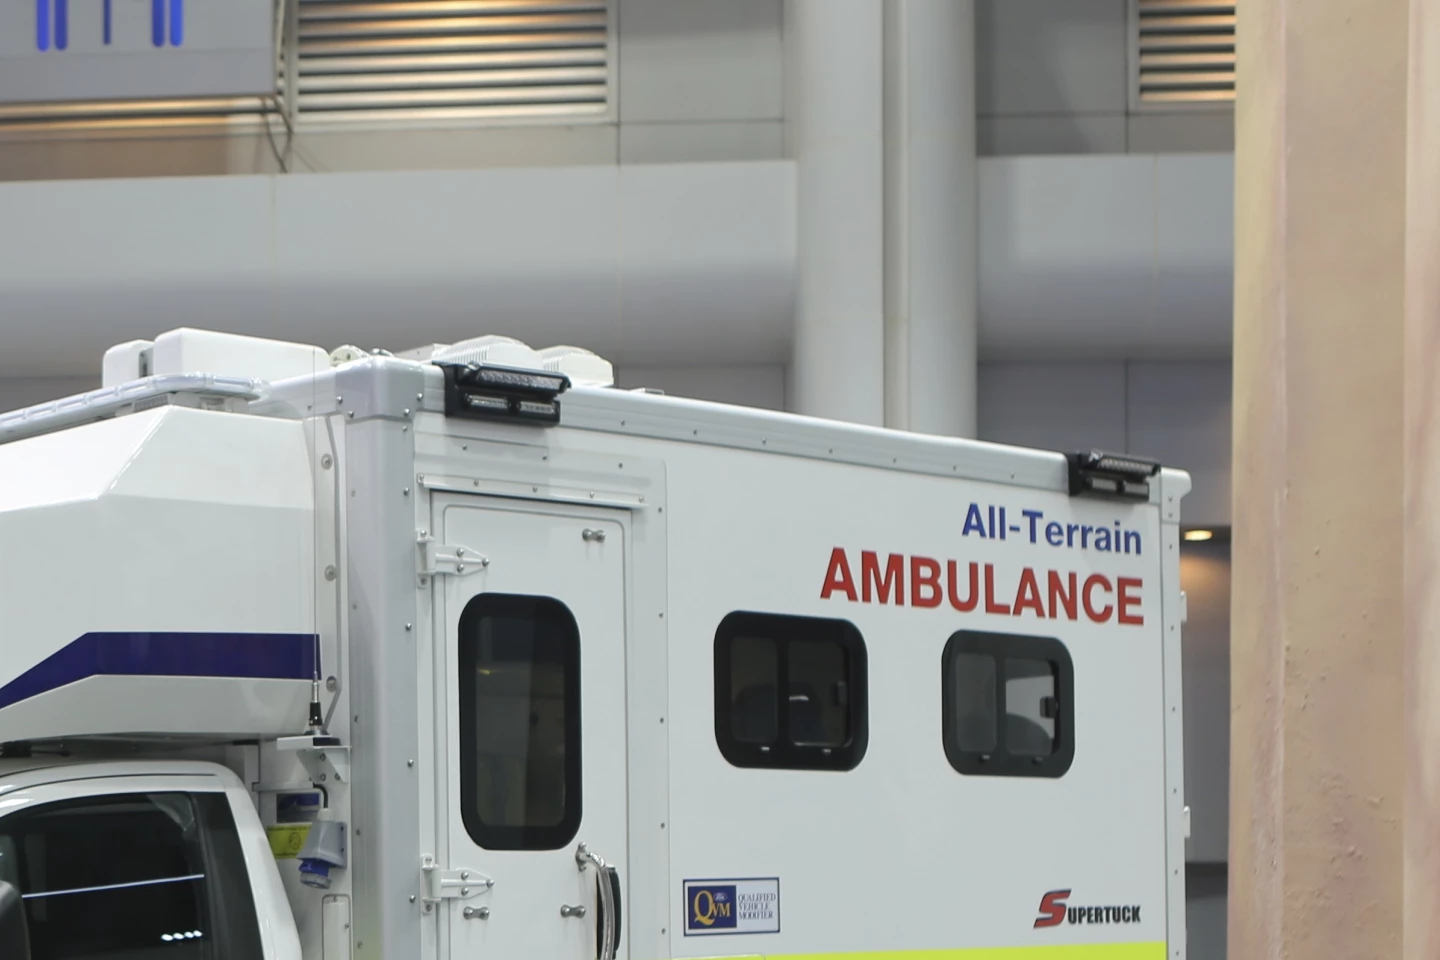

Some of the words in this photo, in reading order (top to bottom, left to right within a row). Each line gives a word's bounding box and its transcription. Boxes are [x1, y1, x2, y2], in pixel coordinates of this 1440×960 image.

[962, 502, 1142, 555] All-Terrain
[819, 546, 1145, 626] AMBULANCE
[693, 890, 731, 926] QVM
[738, 893, 776, 903] QUALIFIED
[738, 911, 774, 920] MODIFIER
[739, 902, 770, 911] VEHICLE
[1033, 888, 1142, 929] SUPERTUCK
